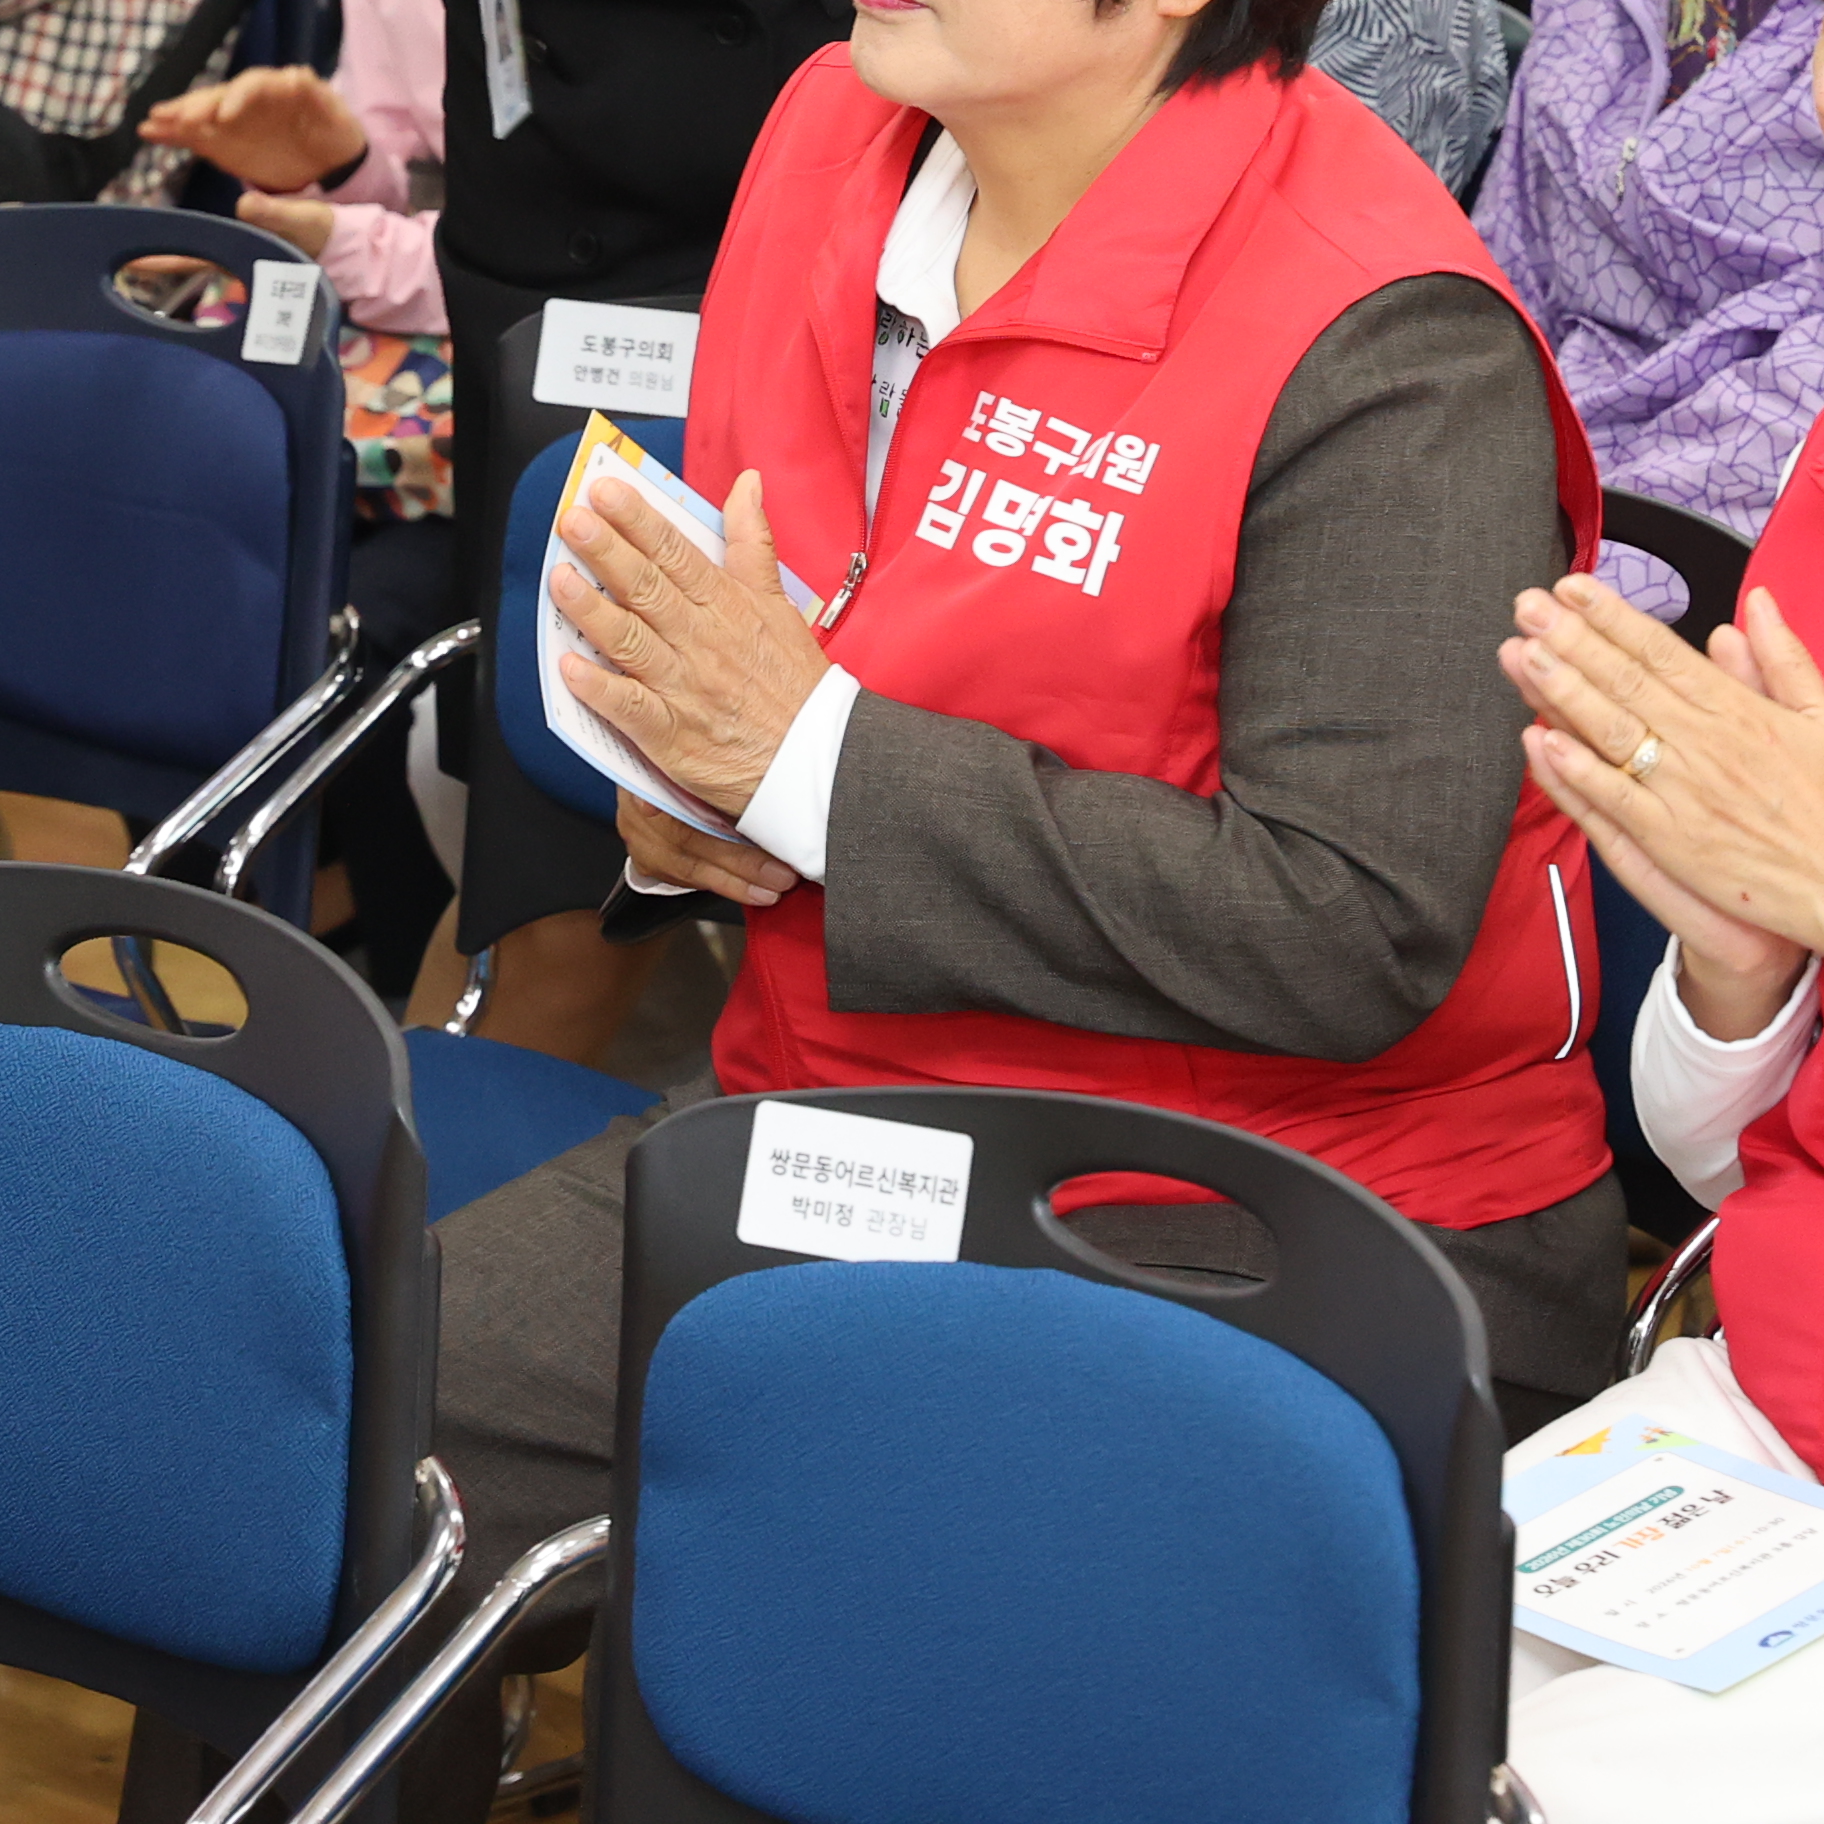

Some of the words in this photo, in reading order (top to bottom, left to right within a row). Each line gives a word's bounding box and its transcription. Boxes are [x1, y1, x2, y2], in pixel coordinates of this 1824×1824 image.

[580, 334, 674, 363] 도봉구의회
[914, 459, 1125, 597] 김명화
[769, 1147, 961, 1207] 쌍문동어르신복지관
[791, 1194, 854, 1228] 박미정
[865, 1208, 928, 1242] 관장님
[1533, 1576, 1582, 1598] 오늘
[1573, 1550, 1622, 1575] 우리
[1612, 1526, 1666, 1549] 가장
[1656, 1504, 1711, 1529] 젊은
[1698, 1489, 1735, 1504] 날
